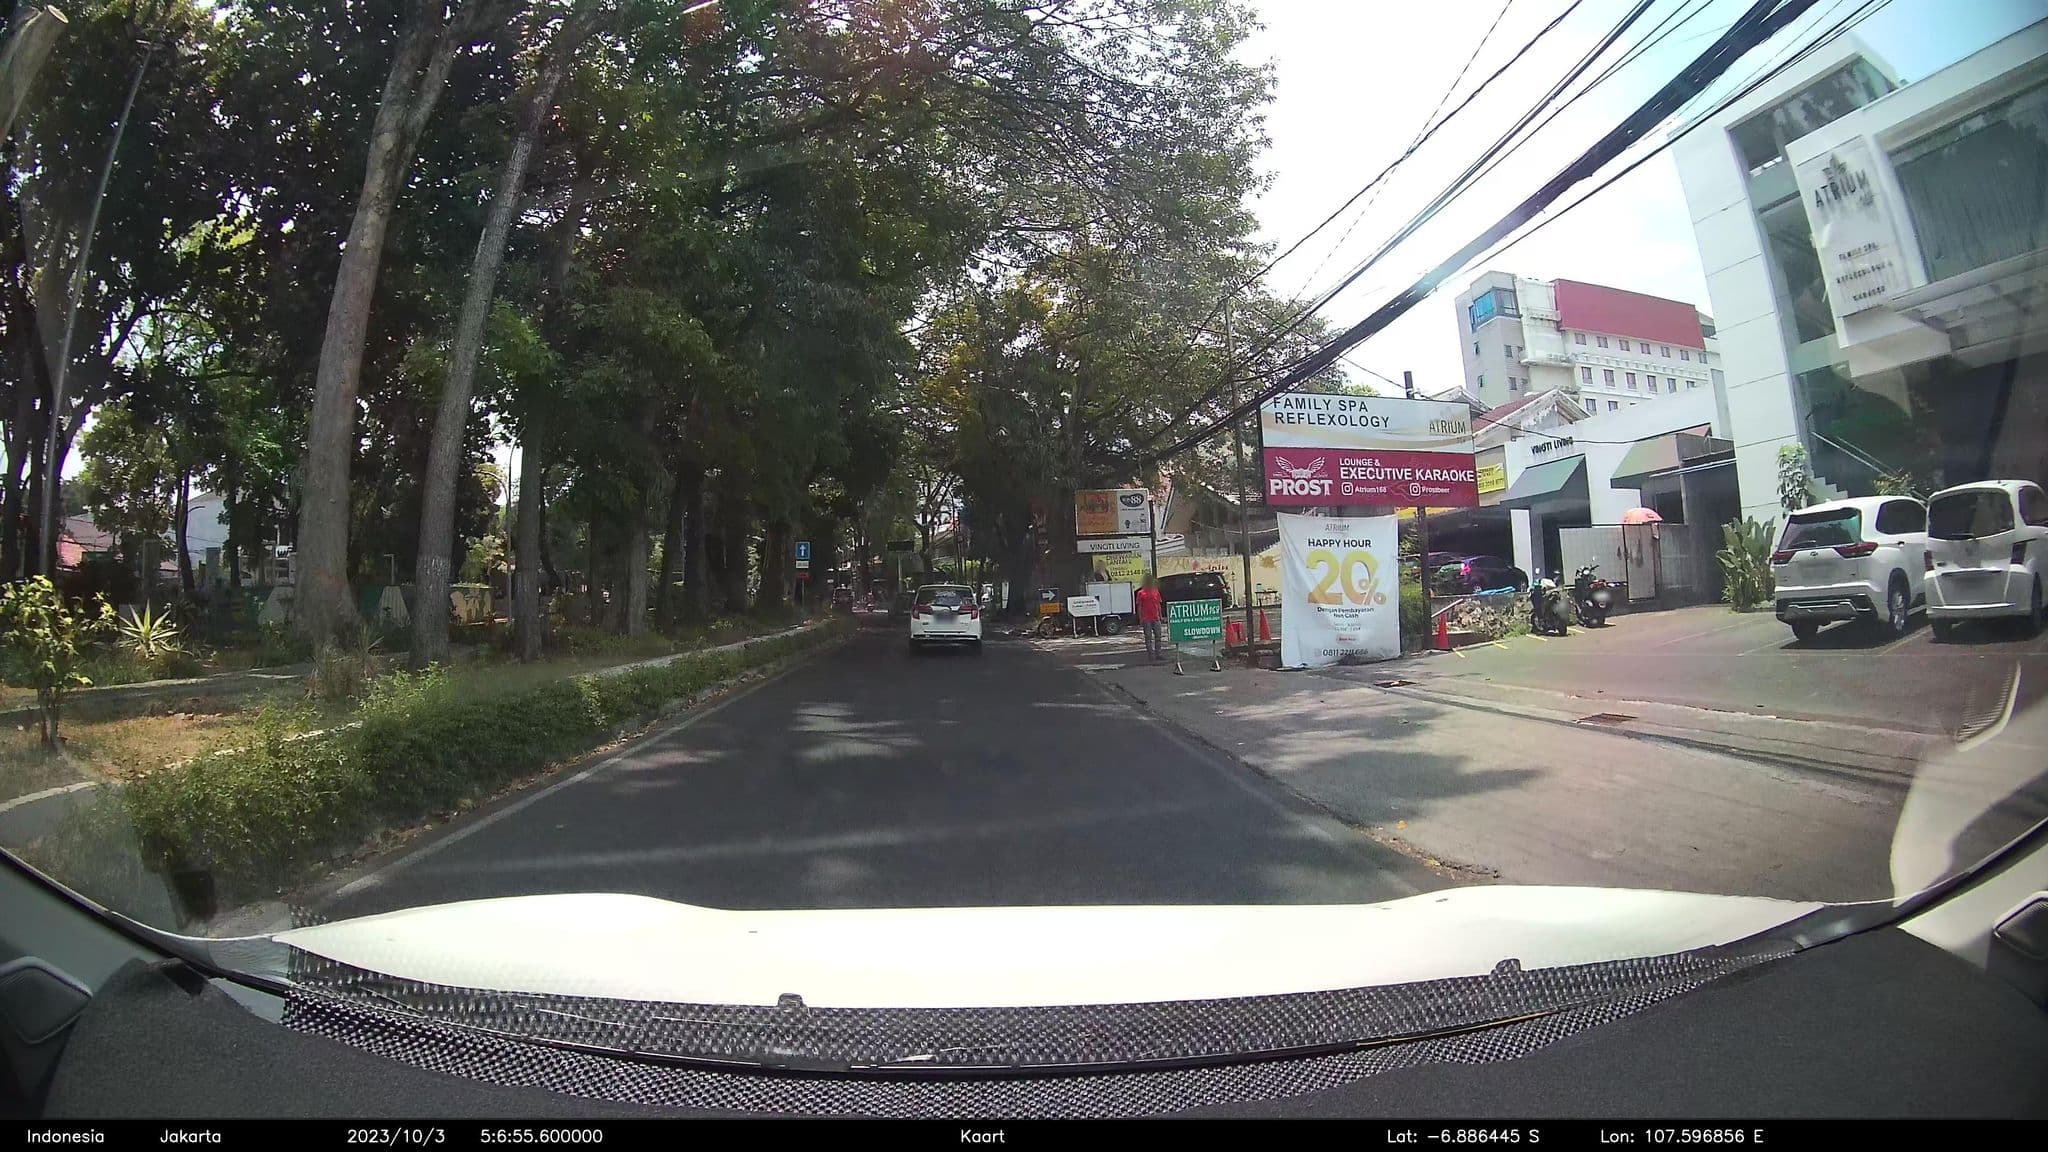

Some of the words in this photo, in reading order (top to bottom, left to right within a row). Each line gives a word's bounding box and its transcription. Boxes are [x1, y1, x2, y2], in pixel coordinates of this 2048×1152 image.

[1814, 169, 1870, 208] ATRIUM
[1273, 396, 1331, 411] FAMILY
[1338, 399, 1369, 413] SPA
[1274, 411, 1390, 429] REFLEXOLOGY
[1429, 419, 1466, 435] ATRIUM
[1553, 436, 1573, 450] LIVING
[1339, 457, 1373, 467] LOUNGE
[1374, 459, 1381, 467] &
[1340, 467, 1412, 481] EXECUTIVE
[1415, 468, 1475, 482] KARAOKE
[1269, 478, 1334, 496] PROST
[1116, 542, 1140, 550] LIVING
[1308, 538, 1341, 548] HAPPY
[1343, 539, 1372, 548] HOUR
[1306, 549, 1387, 606] 20%
